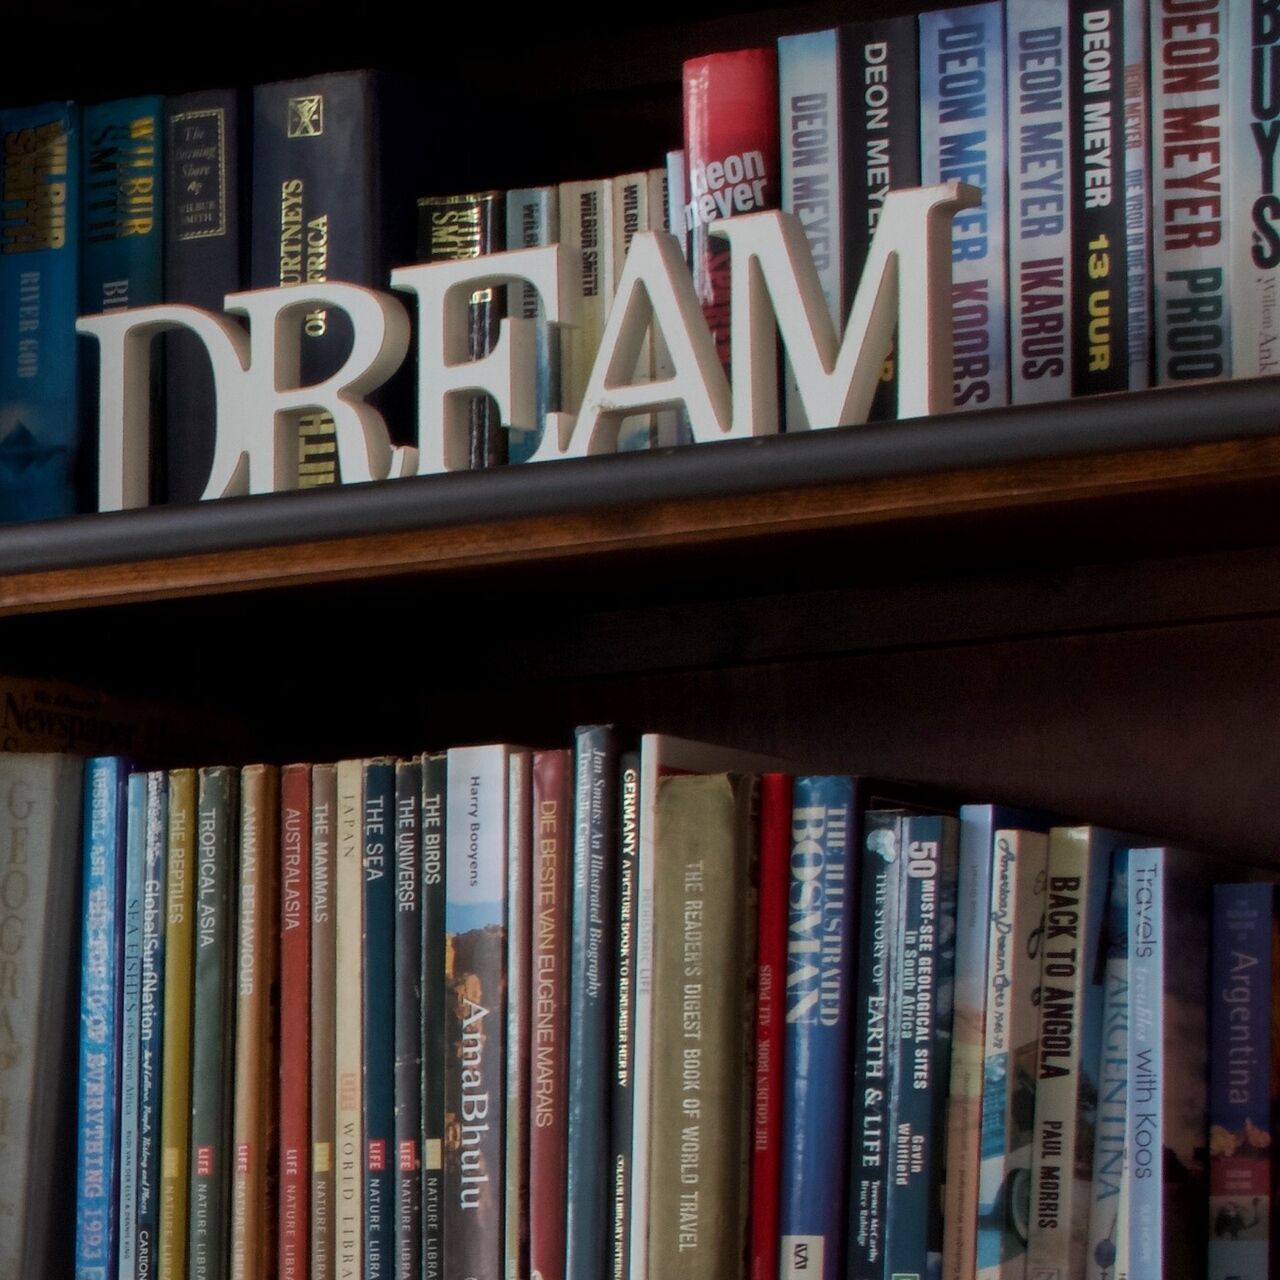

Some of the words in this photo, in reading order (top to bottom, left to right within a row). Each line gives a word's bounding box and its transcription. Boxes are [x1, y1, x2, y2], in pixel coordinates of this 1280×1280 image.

[864, 43, 889, 131] DEON
[1019, 27, 1062, 114] DEON
[1083, 10, 1109, 94] DEON
[791, 93, 828, 167] DEON
[1084, 105, 1112, 209] MEYER
[1020, 123, 1064, 240] MEYER
[1164, 104, 1222, 252] MEYER
[1088, 234, 1109, 278] 13
[75, 184, 980, 516] DREAM
[1021, 257, 1064, 382] IKARUS
[1089, 291, 1112, 374] UUR
[464, 776, 481, 817] Harry
[621, 768, 637, 856] GERMANY
[200, 809, 216, 900] TROPICAL
[285, 809, 301, 931] AUSTRALASIA
[314, 844, 329, 923] MAMMALS
[398, 832, 415, 912] UNIVERSE
[423, 834, 440, 885] BIRDS
[907, 840, 937, 877] 50
[200, 906, 215, 948] ASIA
[785, 804, 826, 1026] BOSMAN
[917, 879, 935, 951] MUST-SEE
[1047, 877, 1081, 938] BACK
[1136, 863, 1158, 958] Travels
[915, 957, 933, 1043] GEOLOGICAL
[1045, 950, 1078, 977] TO
[682, 983, 701, 1038] DIGEST
[867, 995, 887, 1078] EARTH
[1041, 987, 1077, 1080] ANGOLA
[1224, 949, 1257, 1104] Argentina
[459, 999, 490, 1209] AmaBhulu
[536, 1047, 554, 1127] MARAIS
[682, 1049, 700, 1091] BOOK
[912, 1049, 930, 1089] SITES
[1135, 1048, 1157, 1100] with
[681, 1100, 699, 1119] OF
[862, 1115, 883, 1167] LIFE
[1040, 1121, 1063, 1160] PAUL
[1135, 1112, 1157, 1179] Koos
[681, 1128, 700, 1182] WORLD
[679, 1192, 699, 1252] TRAVEL
[1038, 1167, 1060, 1229] MORRIS
